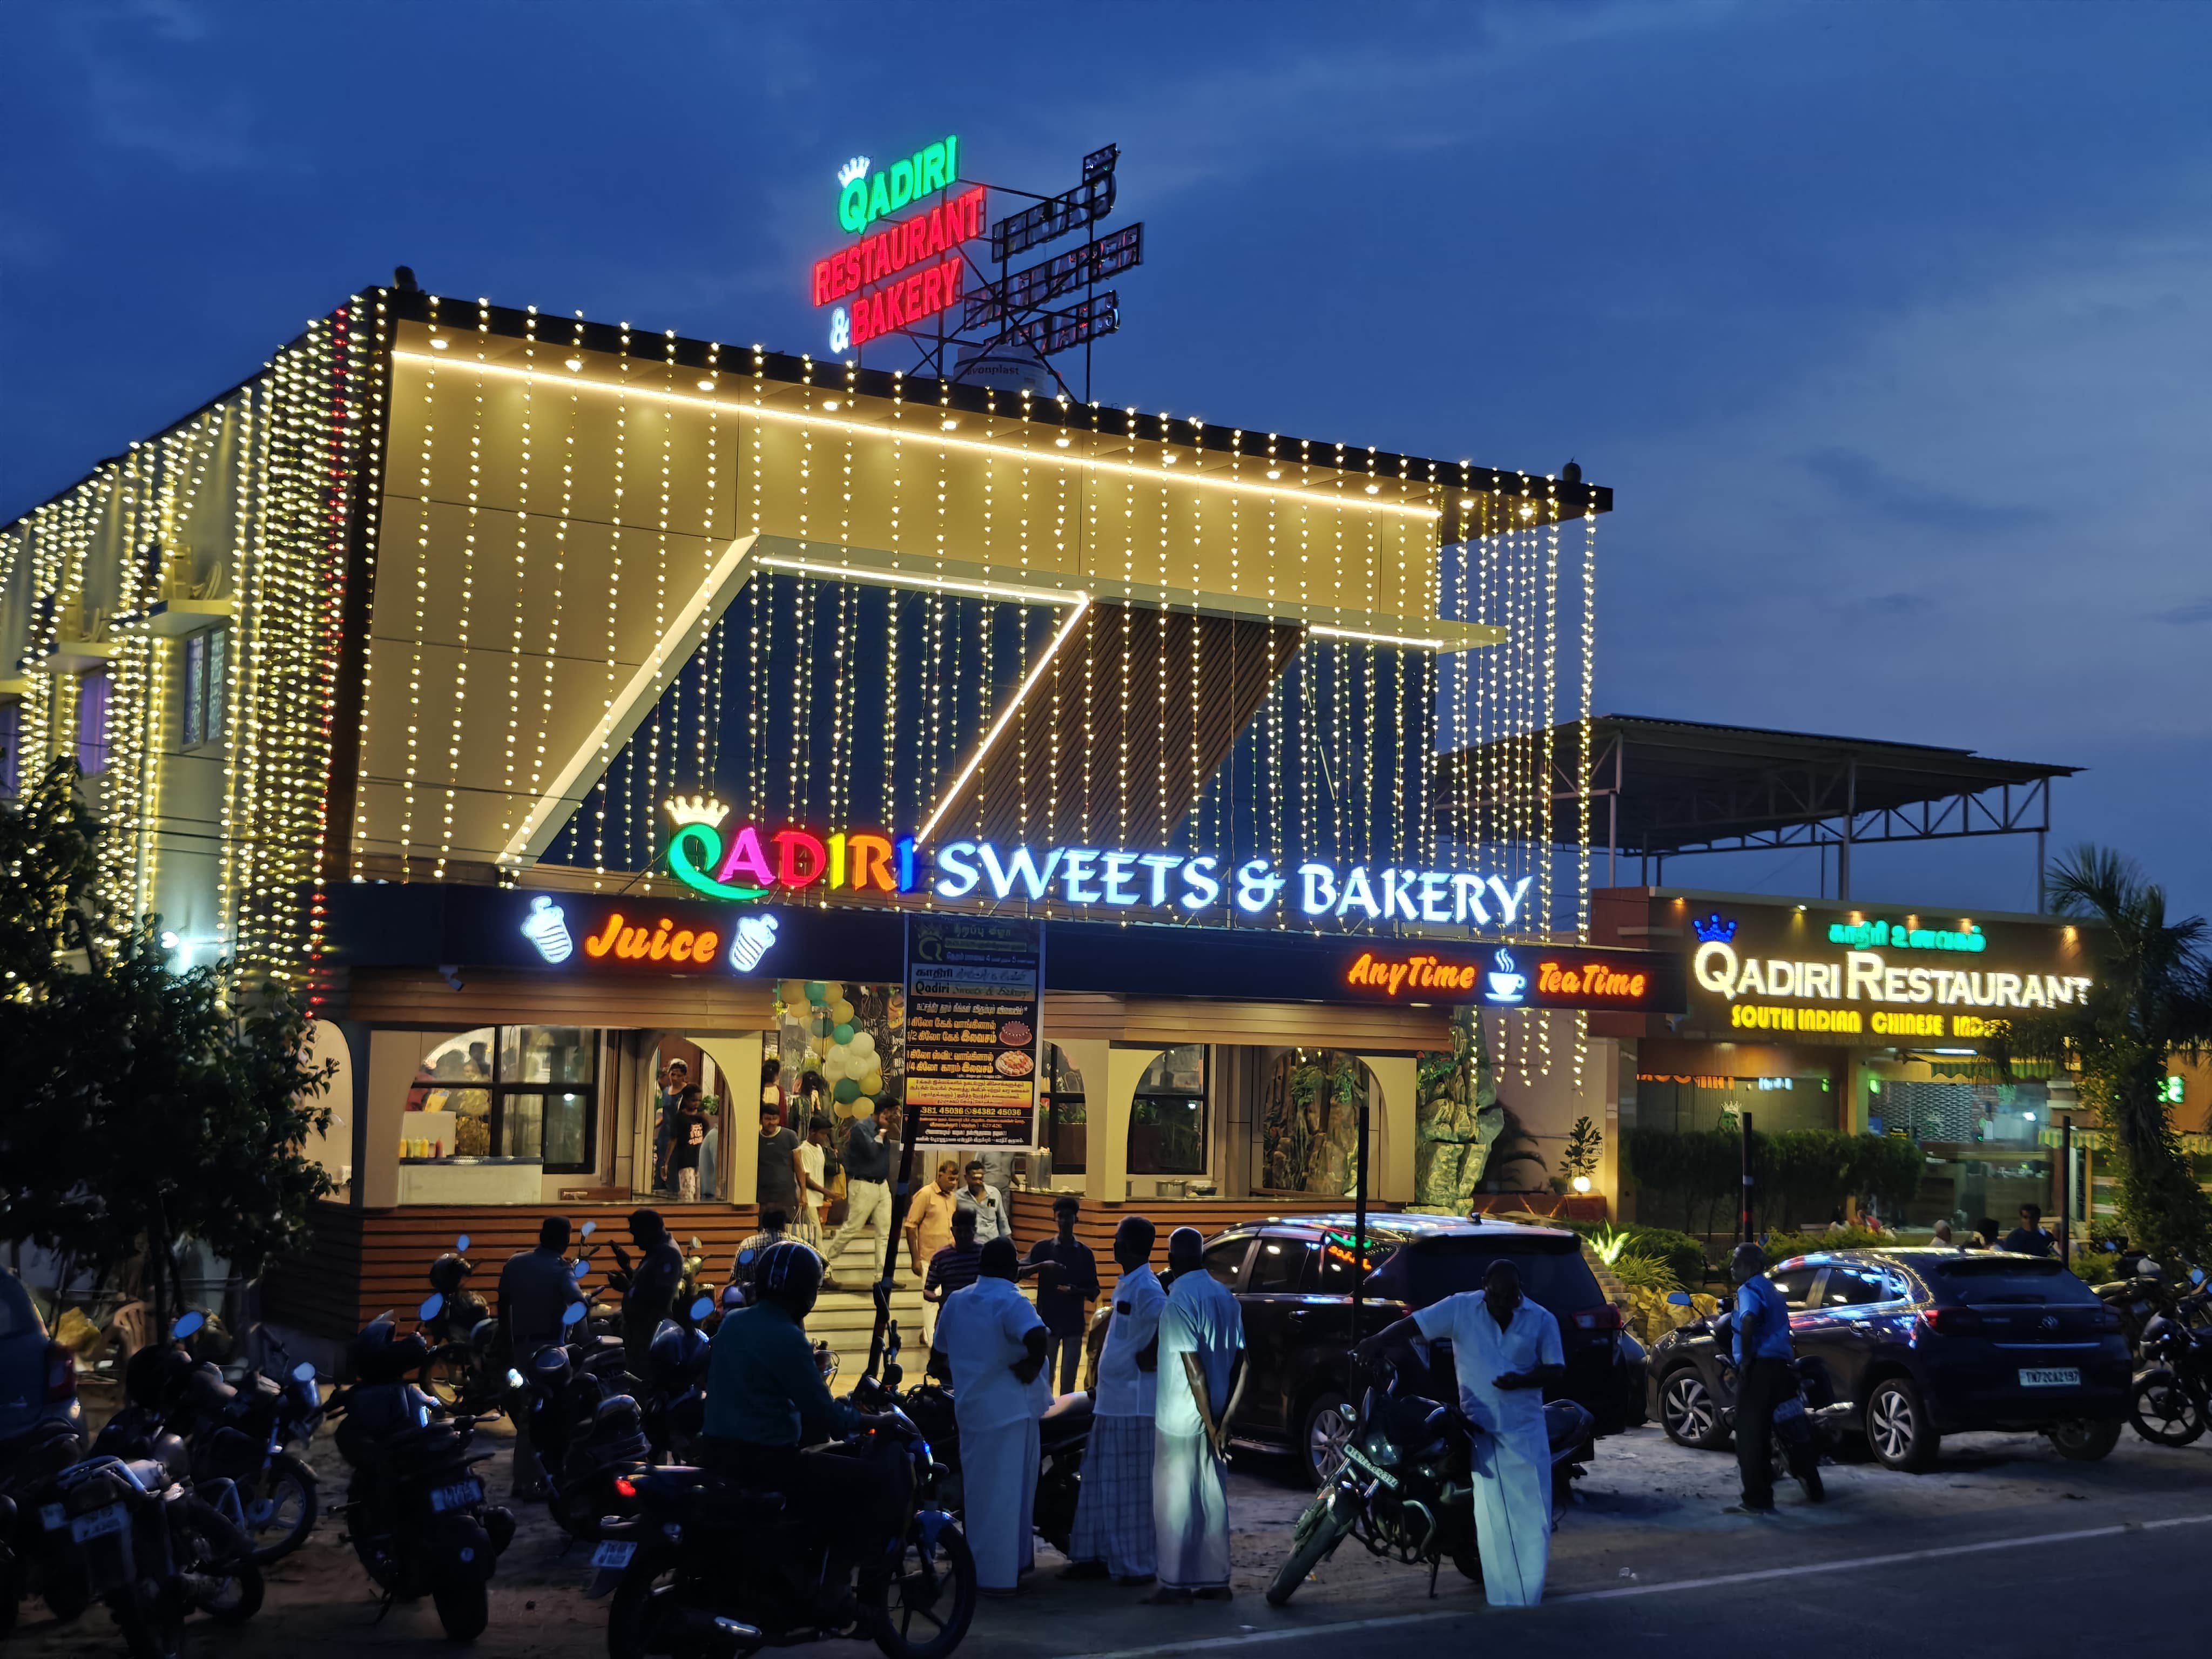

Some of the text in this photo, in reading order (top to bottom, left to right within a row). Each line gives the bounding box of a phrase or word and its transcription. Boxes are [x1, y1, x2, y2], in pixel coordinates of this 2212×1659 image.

[839, 134, 959, 234] QADIRI
[813, 185, 985, 307] RESTAURANT
[830, 306, 849, 354] &
[851, 257, 962, 346] BAKERY
[669, 822, 1533, 927] QADIRI SWEETS & BAKERY
[584, 913, 718, 963] Juice
[916, 981, 949, 995] Qadiri
[1694, 941, 2093, 1009] QADIRI RESTAURANT
[912, 1016, 933, 1028] கிலோ
[935, 1017, 953, 1028] கேக்
[954, 1019, 996, 1030] வாங்கினால்
[919, 1030, 941, 1041] கிலோ
[942, 1031, 960, 1042] கேக்
[961, 1029, 996, 1043] இலவசம்
[1732, 1004, 1795, 1031] SOUTH
[1798, 1008, 1862, 1034] INDIAN
[1871, 1011, 1944, 1037] CHINESE
[911, 1049, 932, 1059] கிலோ
[954, 1051, 994, 1062] வாங்கினால்
[916, 1061, 938, 1072] கிலோ
[941, 1063, 961, 1073] காரம்
[962, 1062, 994, 1074] இலவசம்
